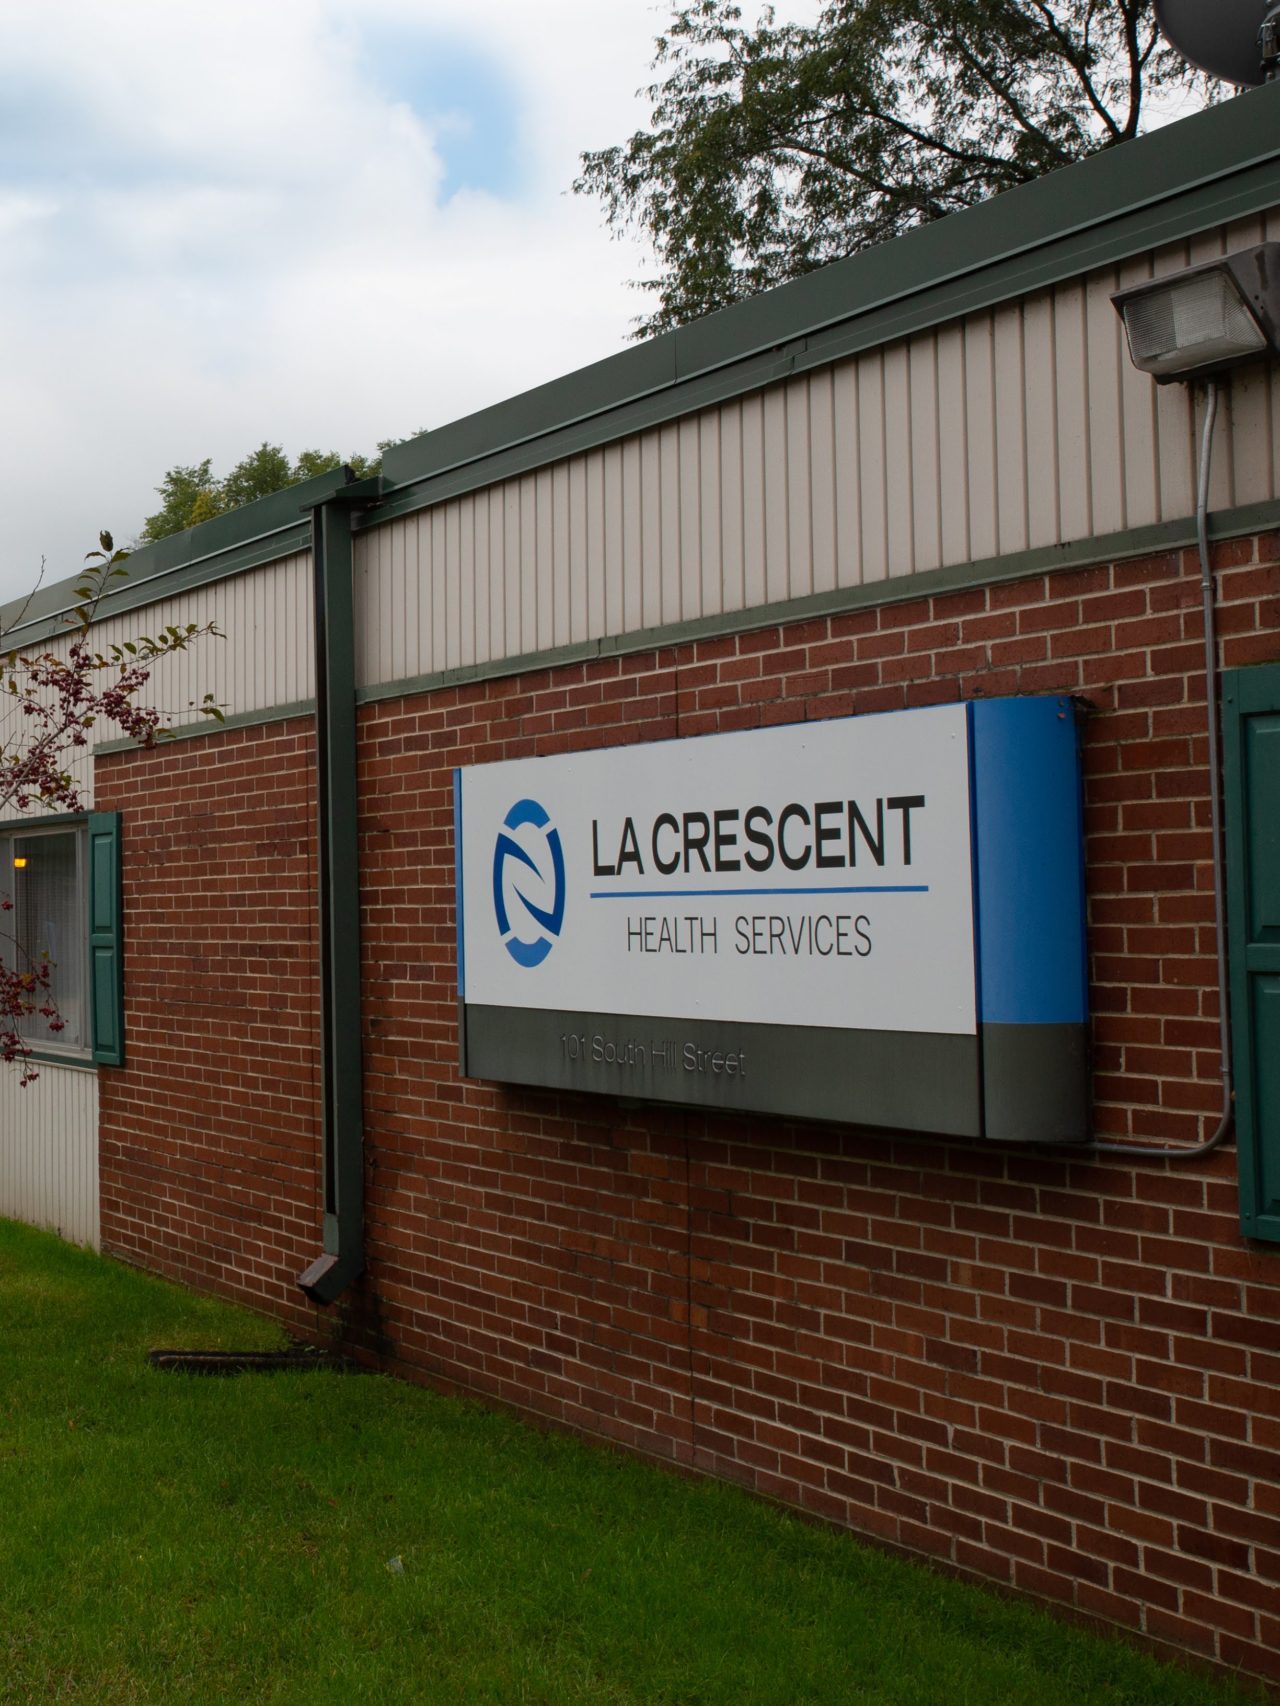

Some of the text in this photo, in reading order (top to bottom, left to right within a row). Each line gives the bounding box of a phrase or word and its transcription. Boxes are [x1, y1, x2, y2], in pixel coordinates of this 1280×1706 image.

[651, 794, 926, 876] CRESCENT
[627, 914, 872, 958] HEALTH SERVICES
[559, 1032, 746, 1076] 101 South Hill Street
